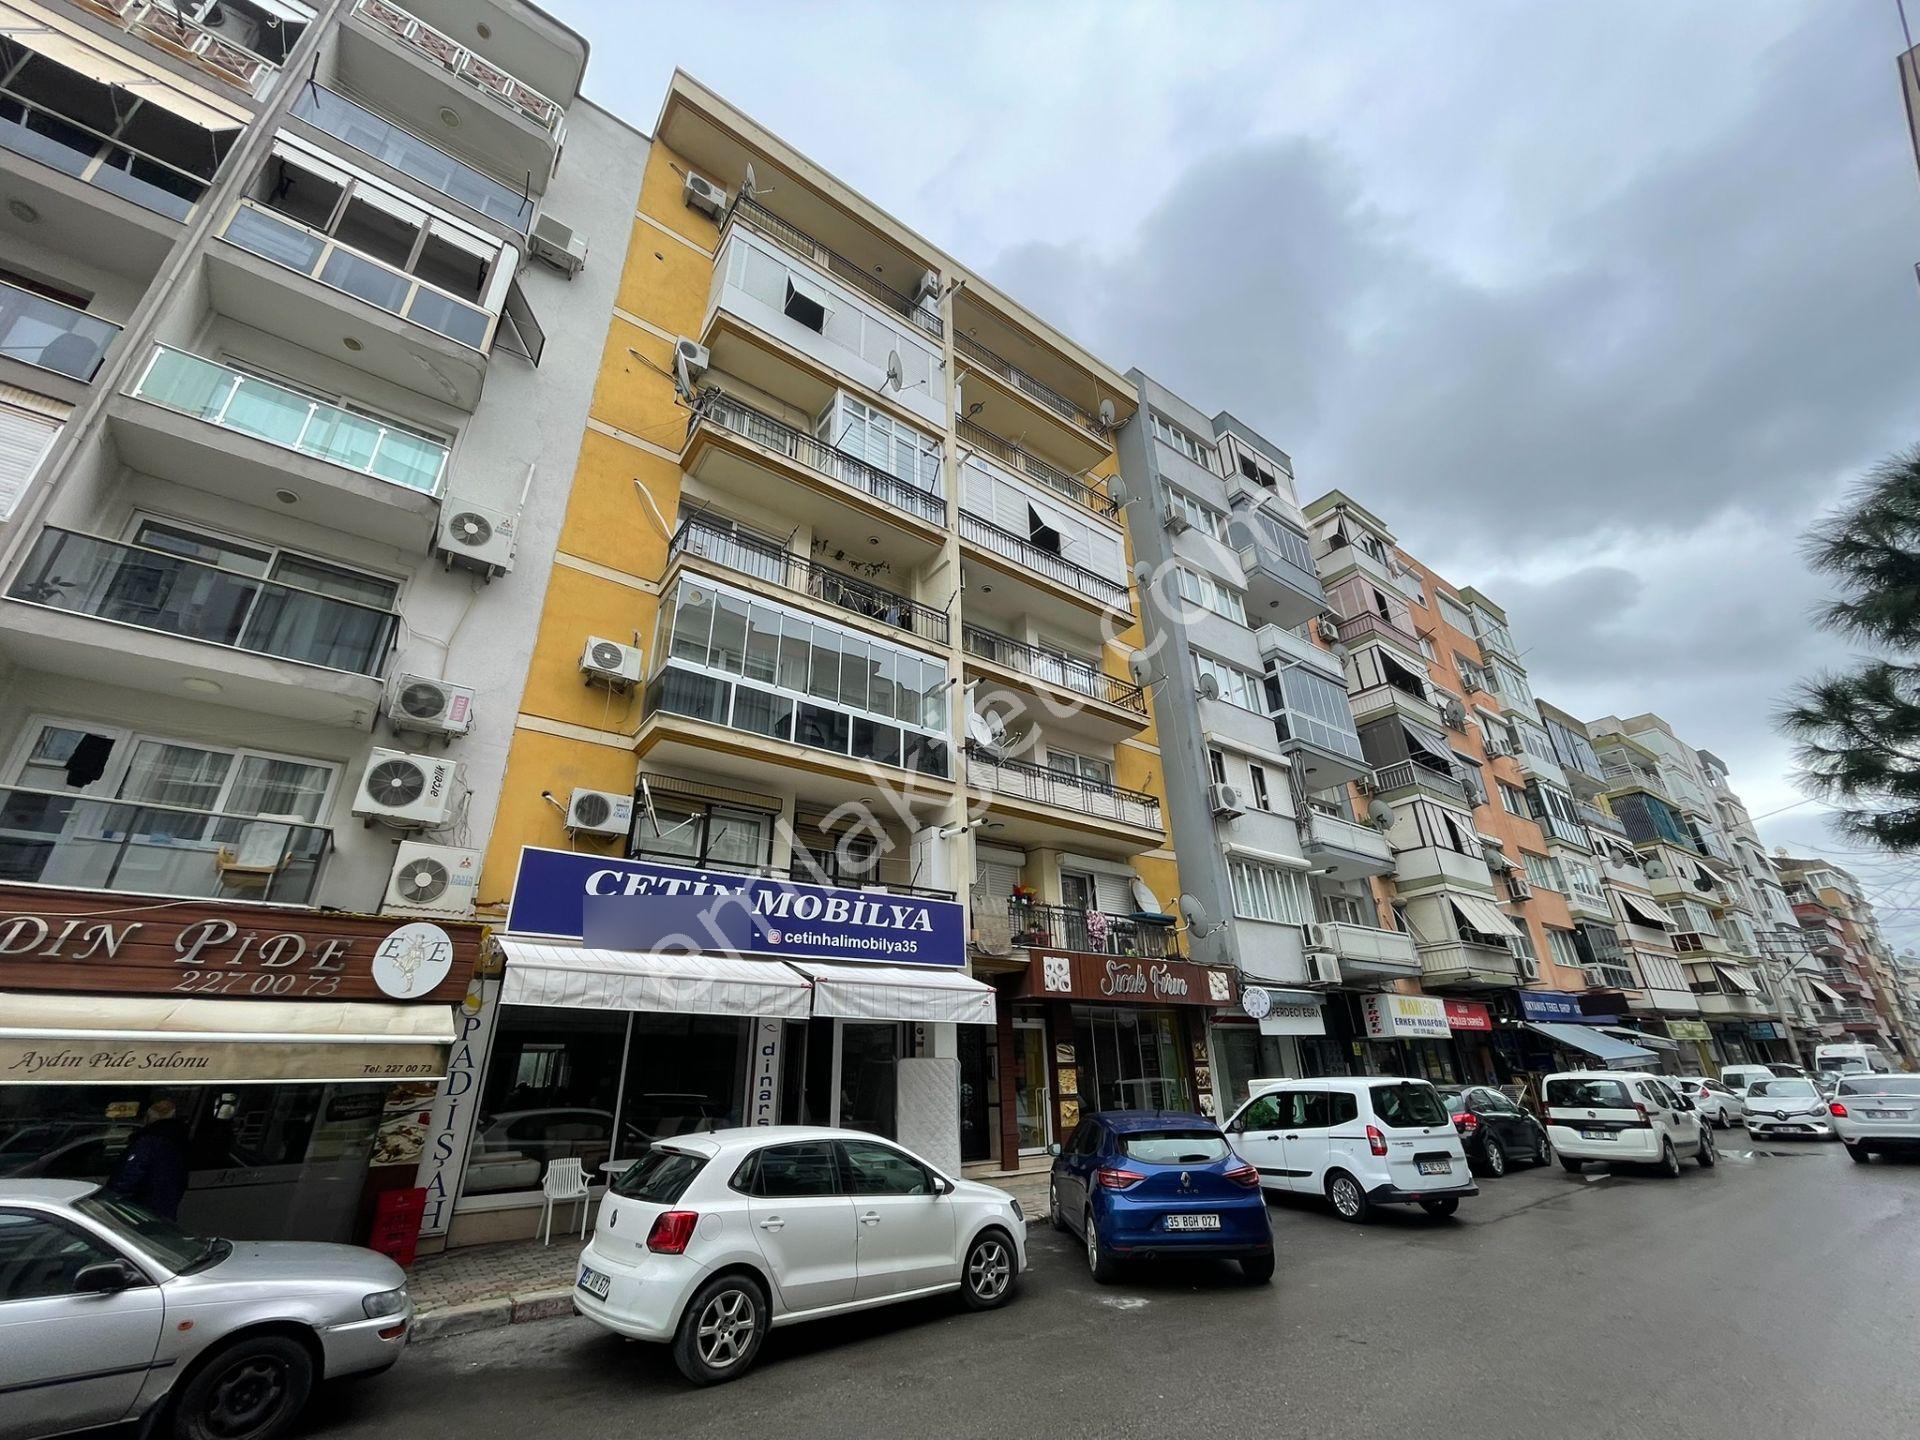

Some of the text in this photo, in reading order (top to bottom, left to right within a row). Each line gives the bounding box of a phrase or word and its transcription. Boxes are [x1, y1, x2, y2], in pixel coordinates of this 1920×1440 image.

[751, 890, 934, 932] MOBİLYA
[174, 918, 354, 972] PİDE
[784, 930, 918, 954] cetinhalimobilya35
[171, 970, 341, 996] 227 00 73
[8, 1050, 210, 1073] Aydın Pide Salonu
[363, 1064, 432, 1073] Tel: 227 00 73
[420, 1017, 481, 1229] PADİŞAH
[1168, 1215, 1217, 1227] 35 BGH 027
